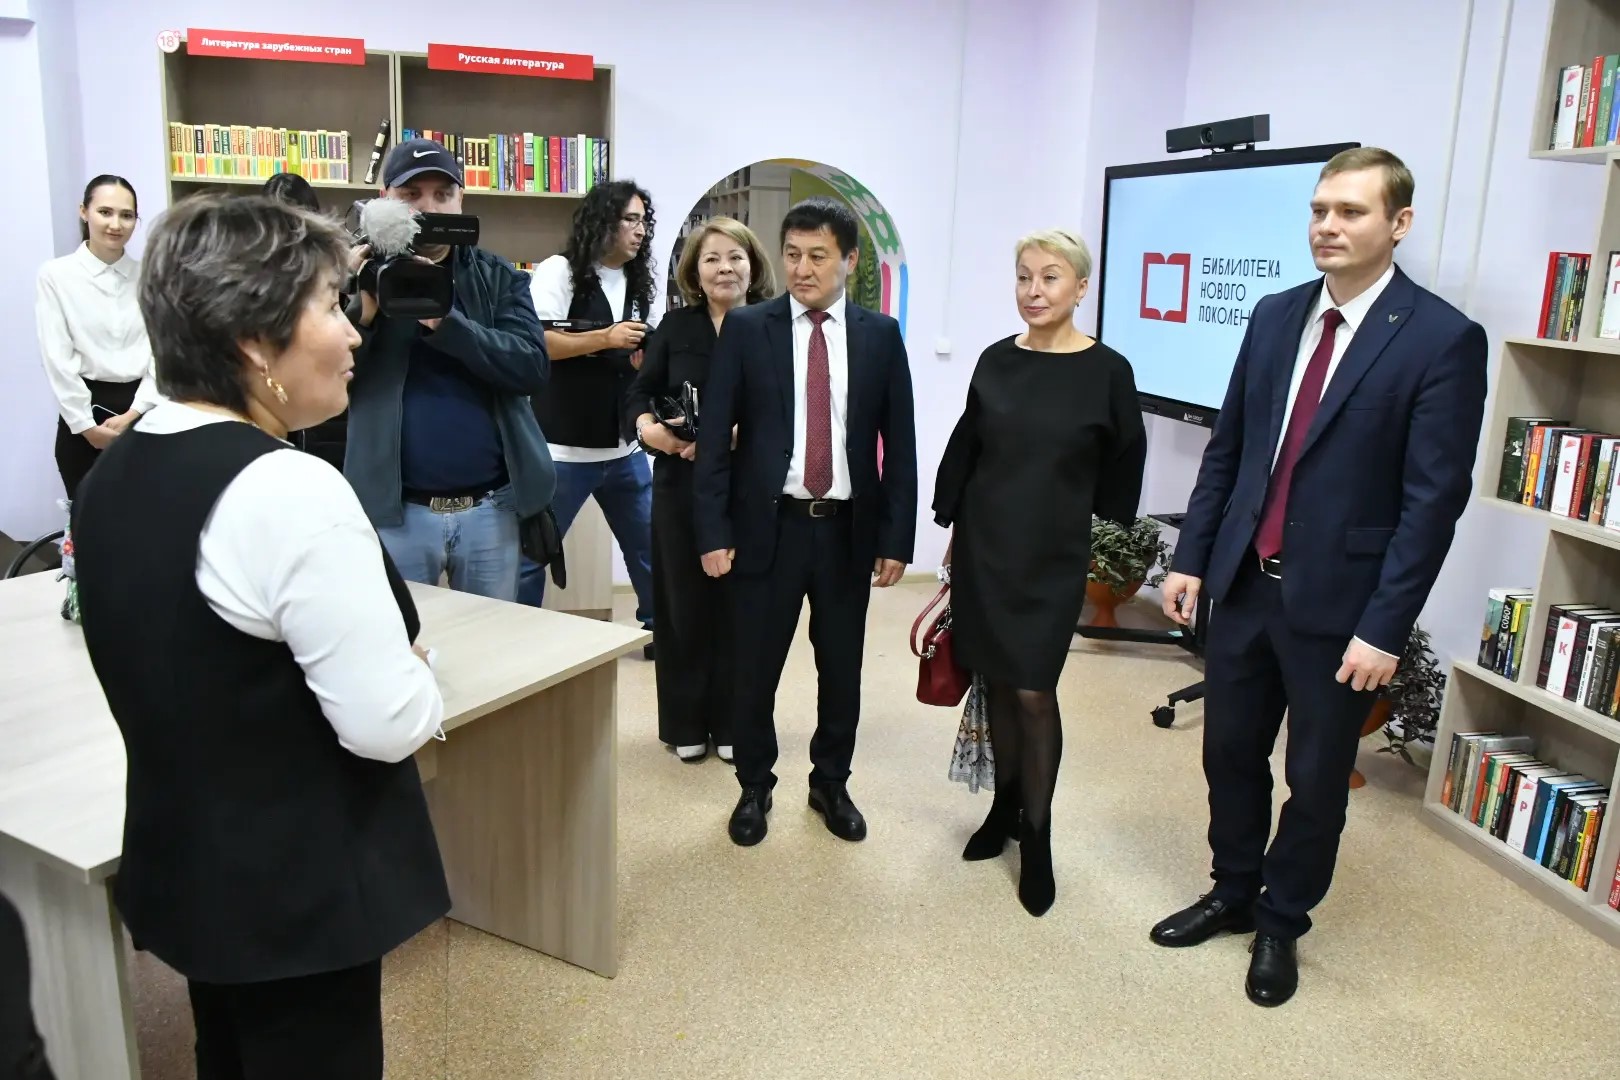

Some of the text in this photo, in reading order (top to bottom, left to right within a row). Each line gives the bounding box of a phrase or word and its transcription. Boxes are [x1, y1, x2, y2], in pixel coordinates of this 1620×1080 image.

[201, 37, 352, 56] Литература зарубежных стран
[458, 52, 565, 71] Русская литература
[1202, 257, 1281, 279] БИБЛИОТЕКА
[1200, 281, 1246, 302] НОВОГО
